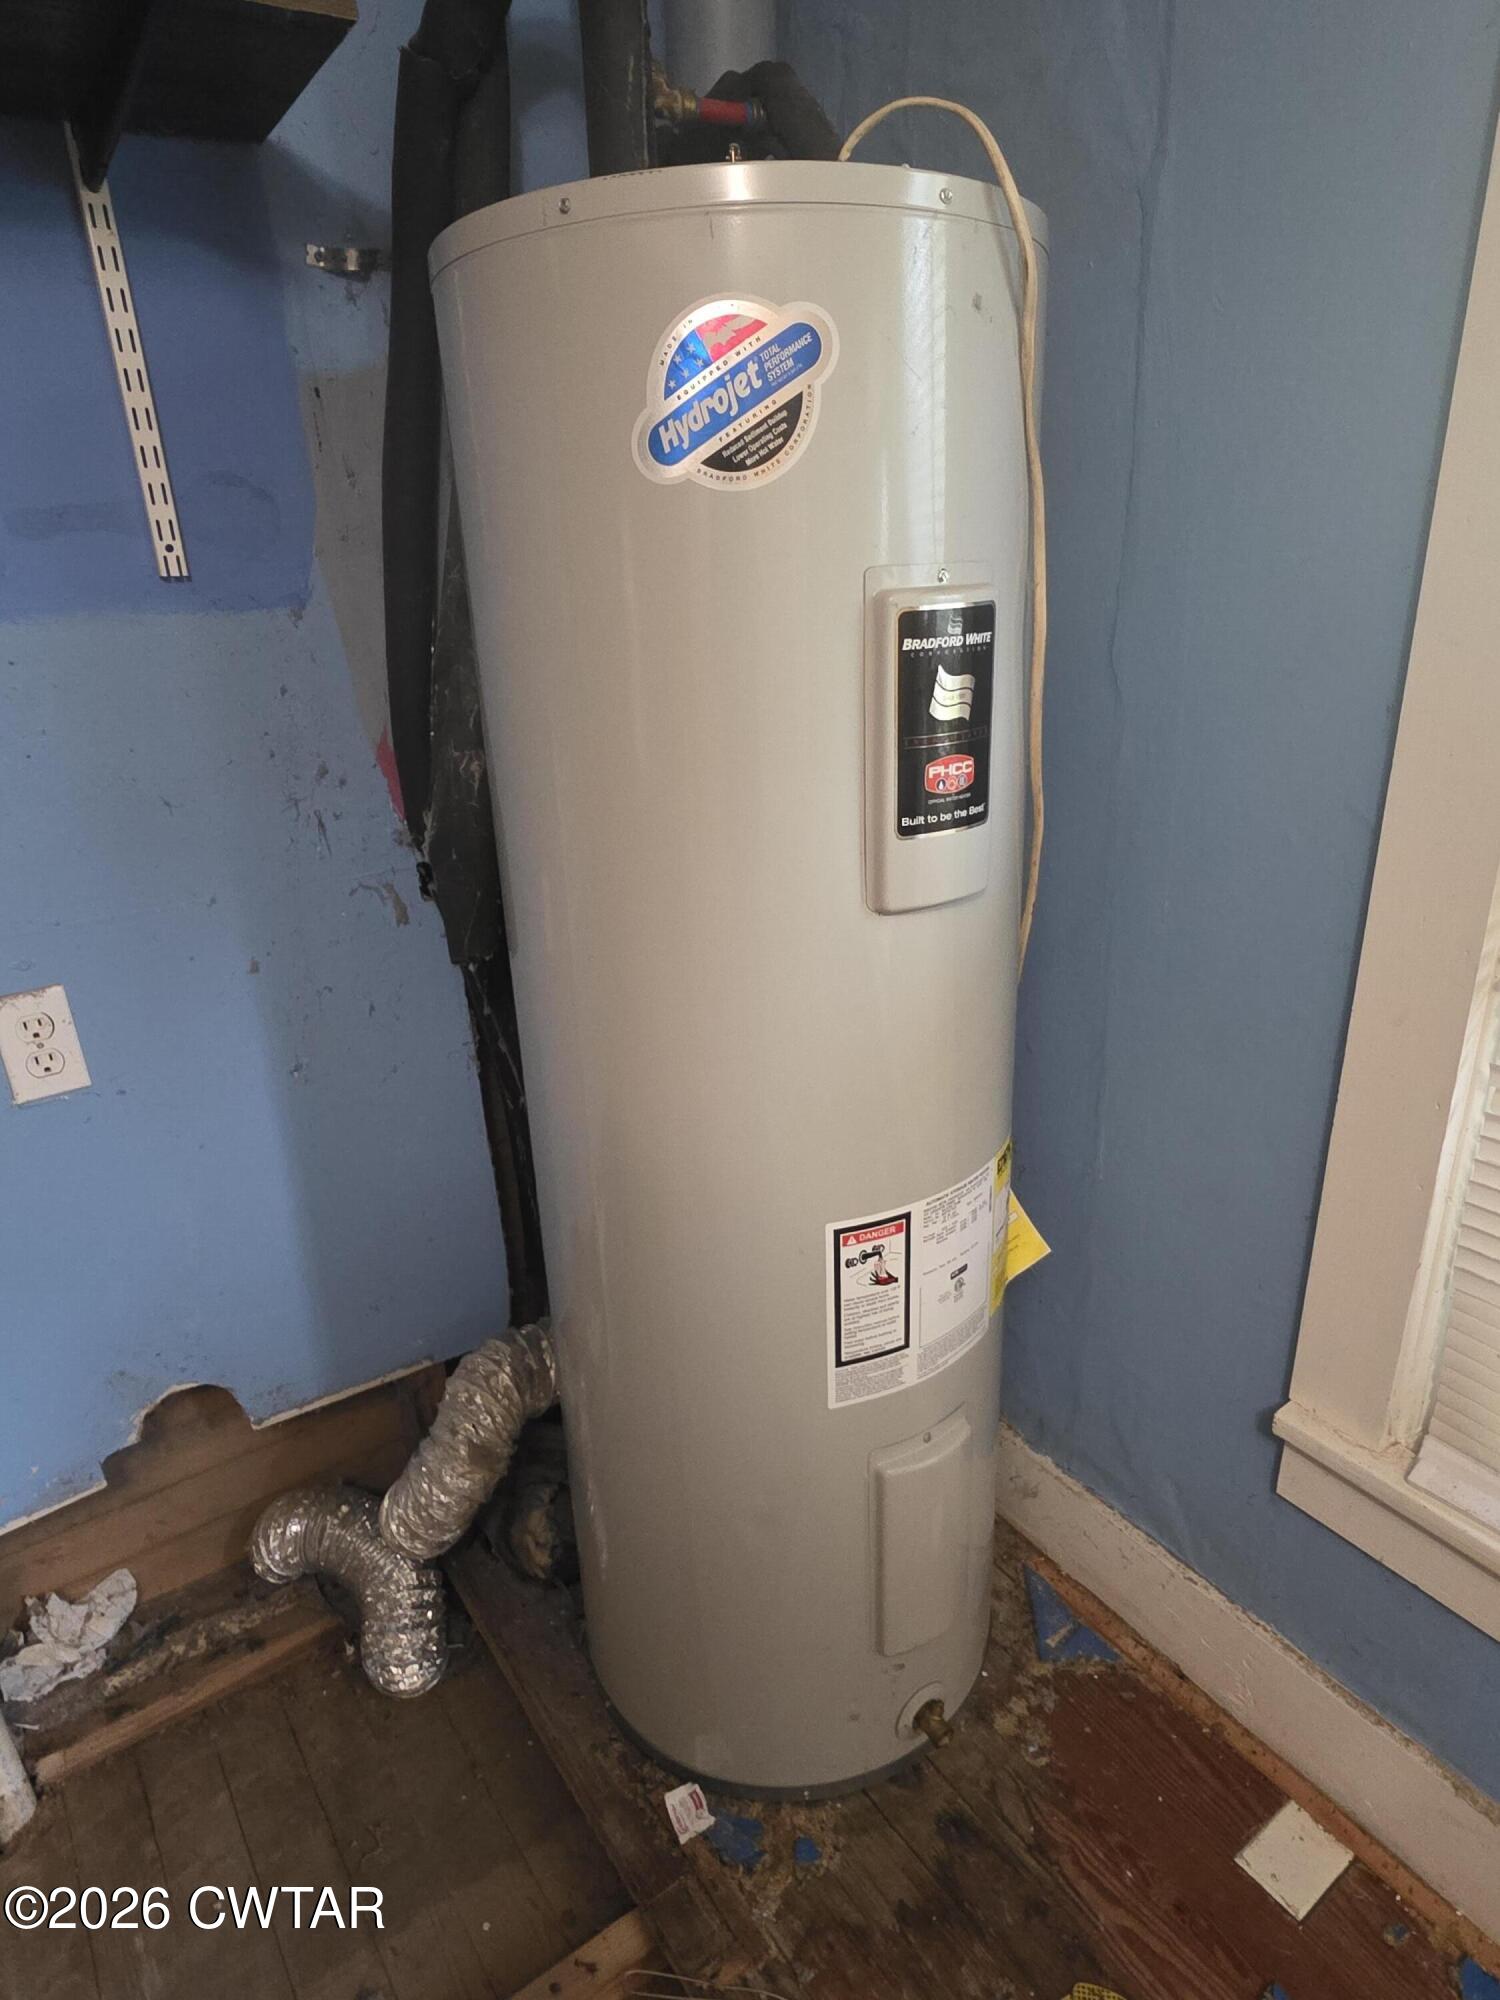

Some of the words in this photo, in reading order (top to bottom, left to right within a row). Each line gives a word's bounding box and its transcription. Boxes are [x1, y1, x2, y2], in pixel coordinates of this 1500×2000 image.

[760, 343, 781, 361] TOTAL
[764, 332, 813, 372] PERFORMANCE
[677, 360, 728, 400] EQUIPPED
[735, 336, 761, 357] WITH
[767, 357, 794, 382] SYSTEM
[658, 360, 762, 454] Hydrojet
[719, 399, 777, 442] FEATURING
[697, 468, 748, 482] BRADFORD
[754, 459, 781, 477] WHITE
[784, 384, 814, 456] CORPORATION
[748, 432, 774, 452] Operating
[902, 635, 964, 651] BRADFORD
[965, 631, 992, 645] WHITE
[928, 760, 973, 778] PHCC
[901, 815, 925, 826] Built
[927, 814, 938, 823] to
[940, 813, 952, 821] be
[954, 809, 967, 818] the
[969, 804, 985, 815] Best
[859, 1225, 896, 1242] DANGER
